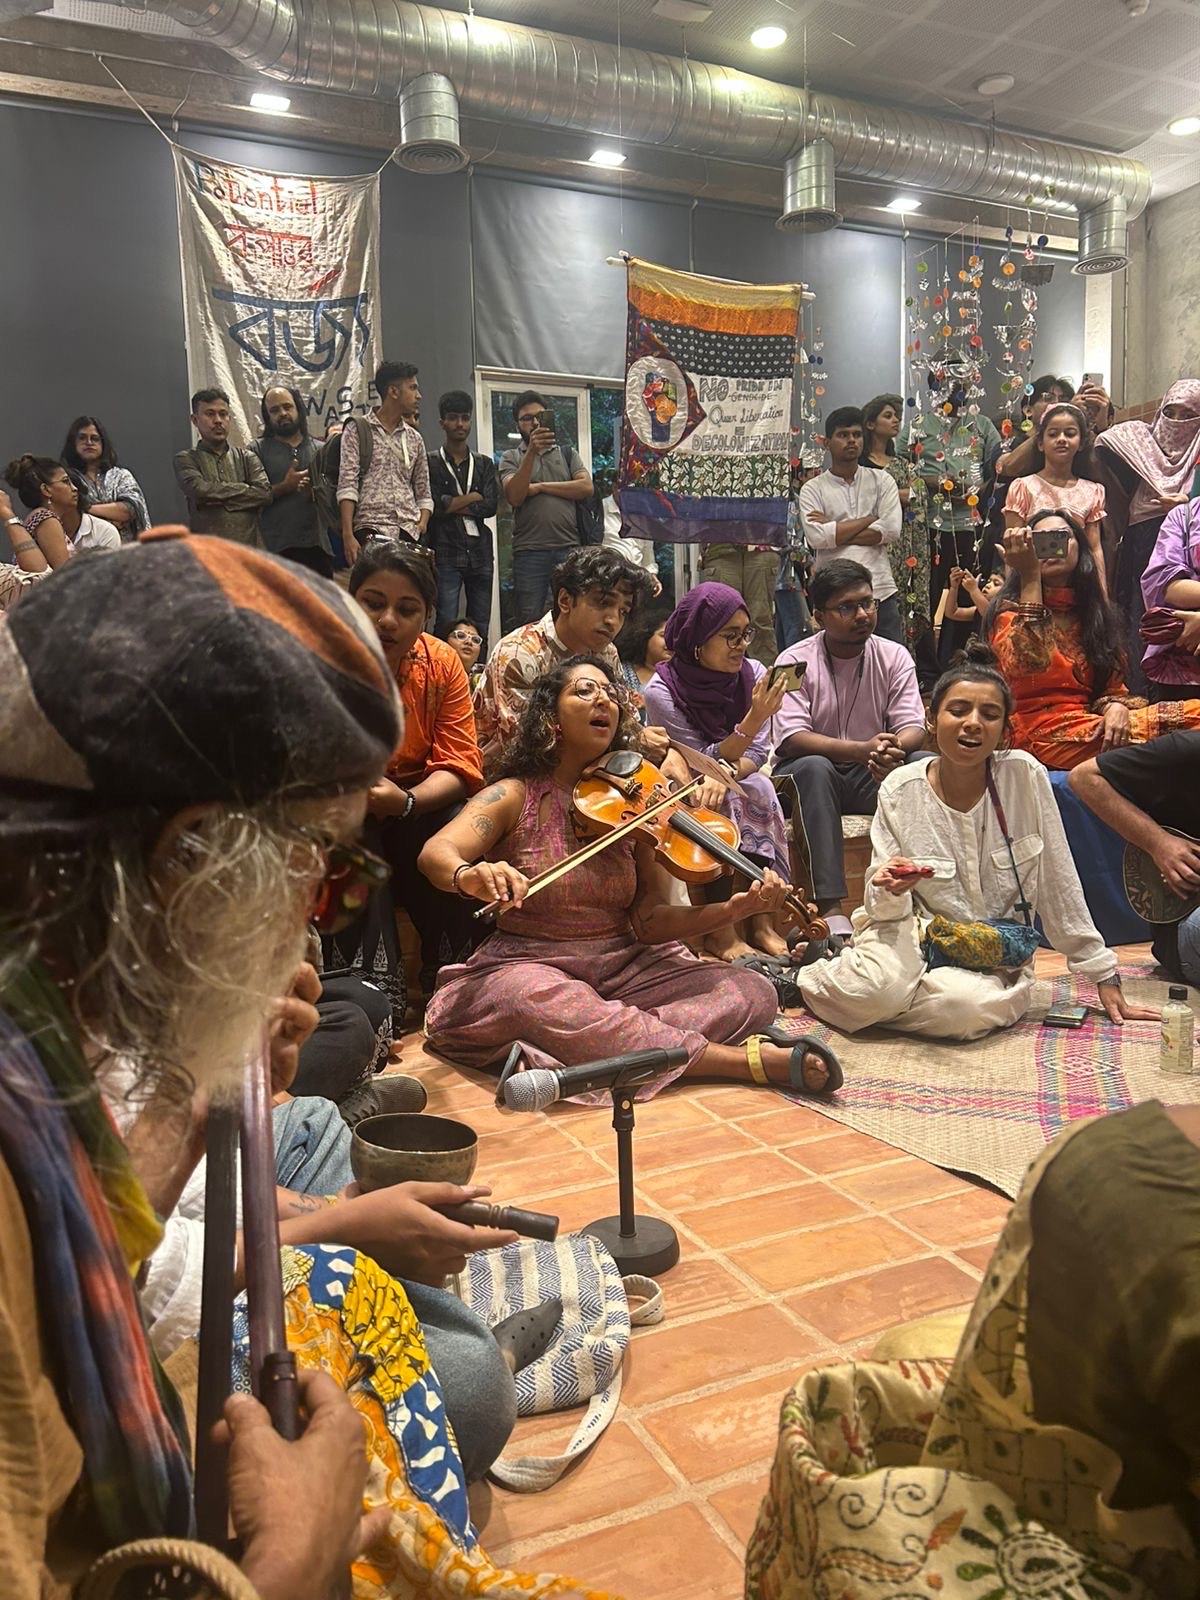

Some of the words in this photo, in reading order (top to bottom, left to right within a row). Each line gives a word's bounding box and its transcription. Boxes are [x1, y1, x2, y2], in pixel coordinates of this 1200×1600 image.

[195, 160, 317, 214] Potential
[699, 377, 729, 403] NO
[692, 433, 789, 452] DECOLONIZATION
